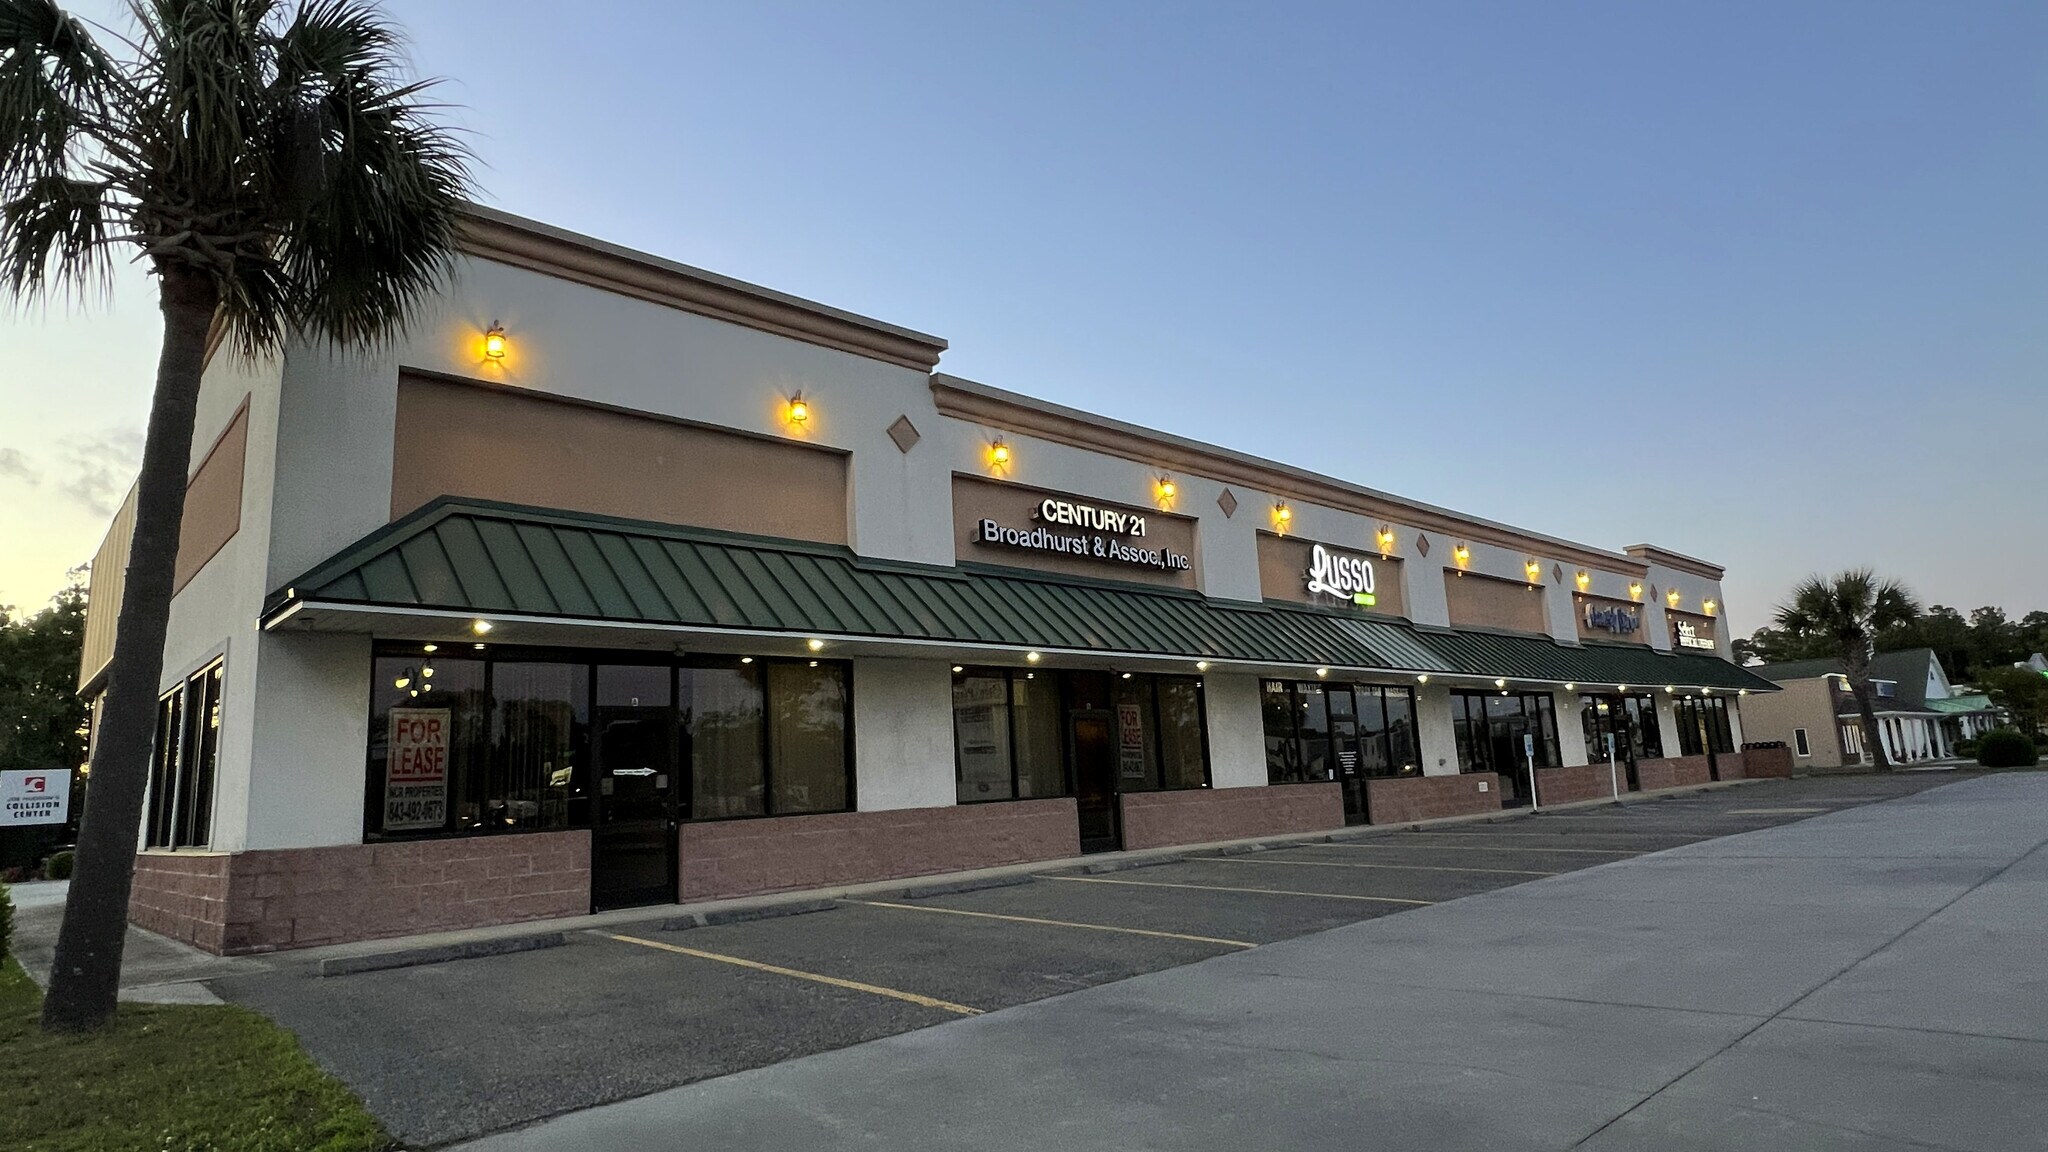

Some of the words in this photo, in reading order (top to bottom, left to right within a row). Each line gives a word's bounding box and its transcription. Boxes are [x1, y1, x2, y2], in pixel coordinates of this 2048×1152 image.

[1042, 499, 1126, 533] CENTURY
[1129, 515, 1146, 537] 21
[983, 518, 1089, 555] Broadhurst
[1093, 536, 1106, 558] &
[1266, 681, 1284, 693] HAIR
[1120, 710, 1138, 726] FOR
[396, 718, 441, 743] FOR
[390, 746, 444, 775] LEASE
[6, 802, 60, 810] COLLISION
[13, 810, 51, 818] CENTER
